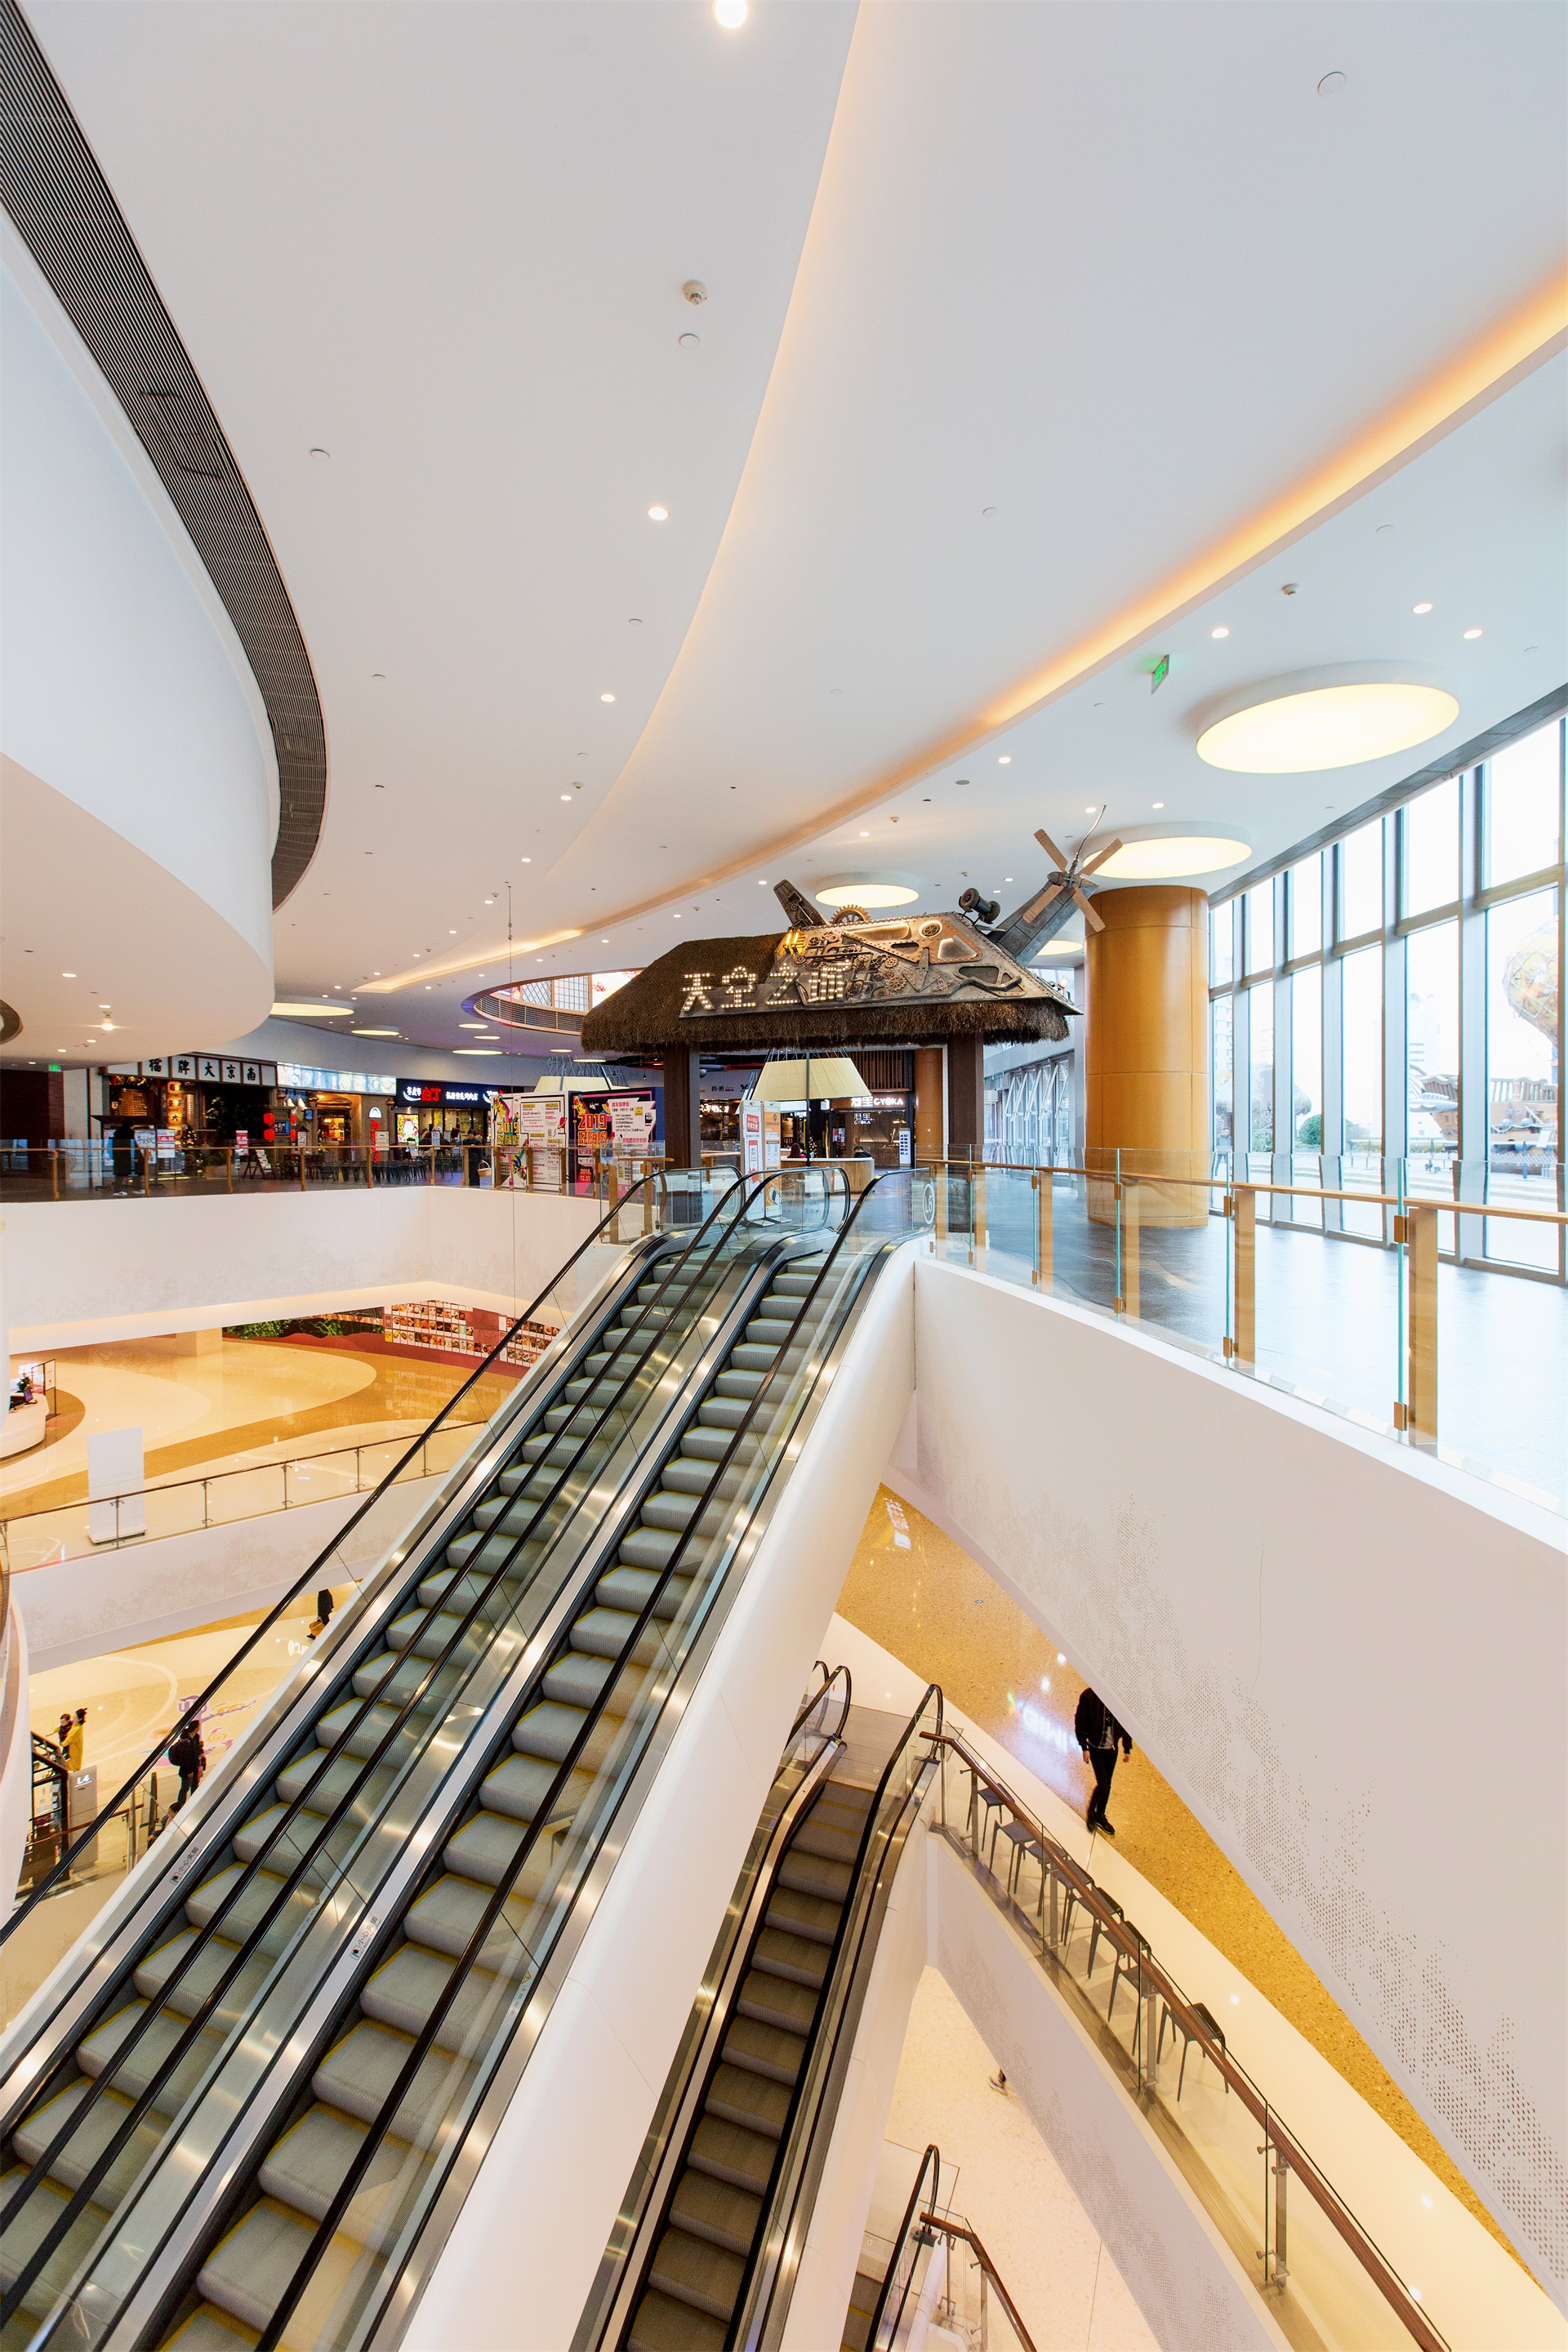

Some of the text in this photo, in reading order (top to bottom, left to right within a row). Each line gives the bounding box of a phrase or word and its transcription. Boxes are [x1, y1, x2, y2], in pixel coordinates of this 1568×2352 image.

[680, 960, 851, 1012] 天空之城
[874, 1098, 903, 1106] GYOKA
[497, 1122, 519, 1134] 2019
[577, 1114, 607, 1130] 2019
[924, 1195, 933, 1213] L6
